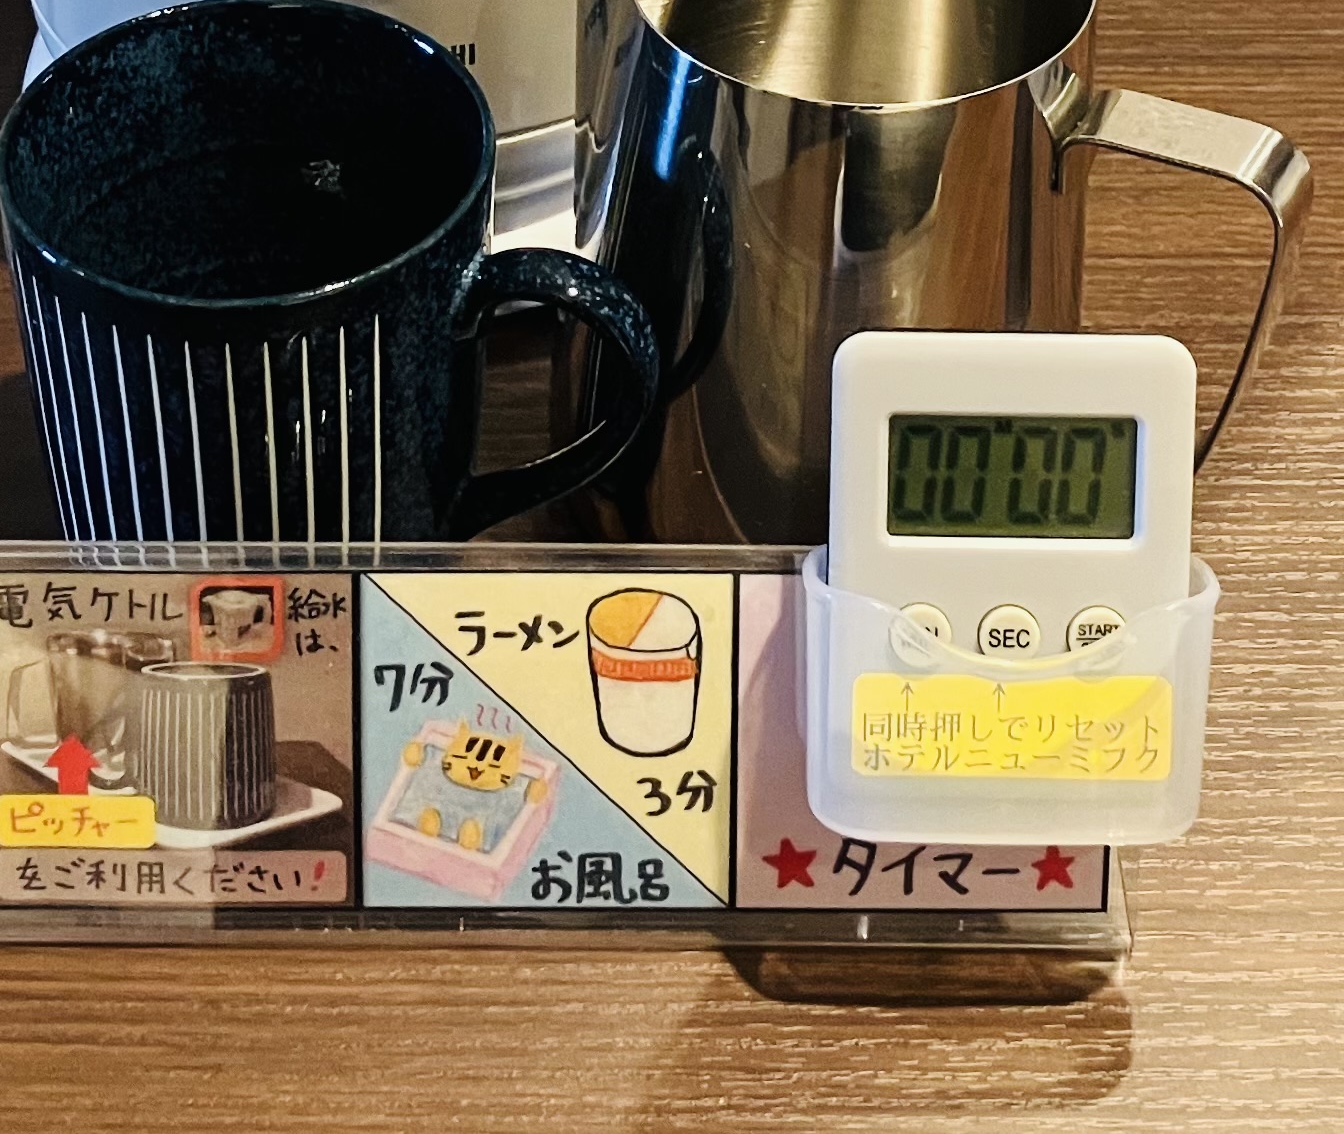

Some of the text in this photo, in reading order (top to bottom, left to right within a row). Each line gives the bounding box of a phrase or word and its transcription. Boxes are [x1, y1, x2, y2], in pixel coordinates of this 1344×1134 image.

[287, 587, 347, 622] 給水
[454, 610, 580, 656] ラーメン
[988, 628, 1031, 648] SEC
[373, 661, 455, 712] 7分
[862, 712, 1160, 743] 同時押しでリセット
[863, 743, 1159, 773] ホテルニューミフク
[636, 769, 718, 817] 3分
[10, 802, 138, 838] ピッチャー
[531, 850, 670, 904] お風呂
[832, 838, 1021, 896] タイマー
